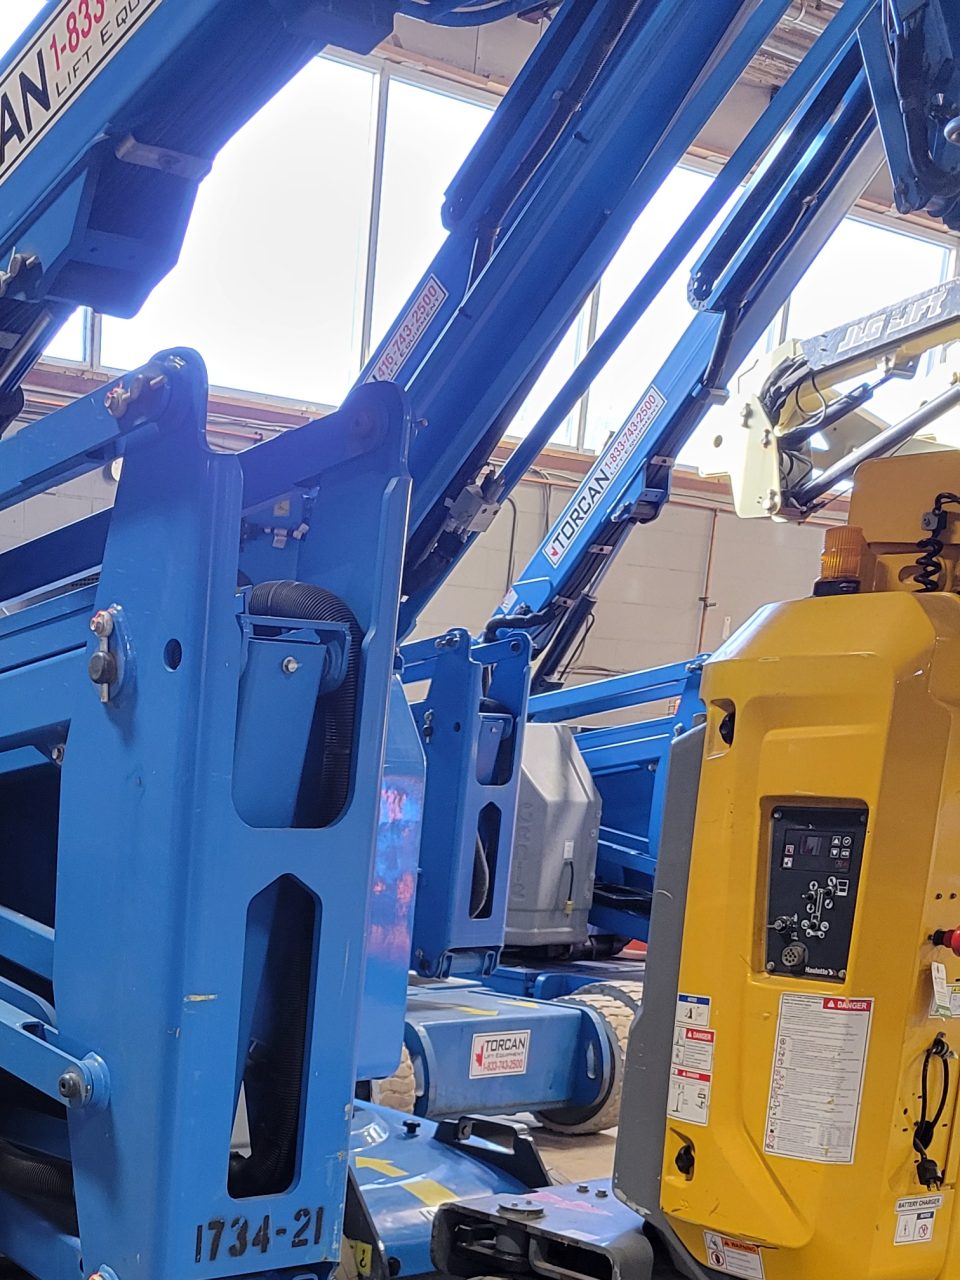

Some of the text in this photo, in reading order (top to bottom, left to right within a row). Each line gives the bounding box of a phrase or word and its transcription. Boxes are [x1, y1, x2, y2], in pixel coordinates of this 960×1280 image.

[55, 45, 93, 98] LIFT
[400, 298, 439, 358] EQUIPMENT
[552, 394, 656, 549] TORCAN 1-833-743-2500
[805, 965, 828, 976] Haulotte
[837, 1001, 868, 1010] DANGER
[692, 1031, 712, 1042] DANGER
[485, 1037, 526, 1052] TORCAN
[898, 1197, 941, 1209] BATTERY CHARGER
[195, 1206, 325, 1263] 1734-21
